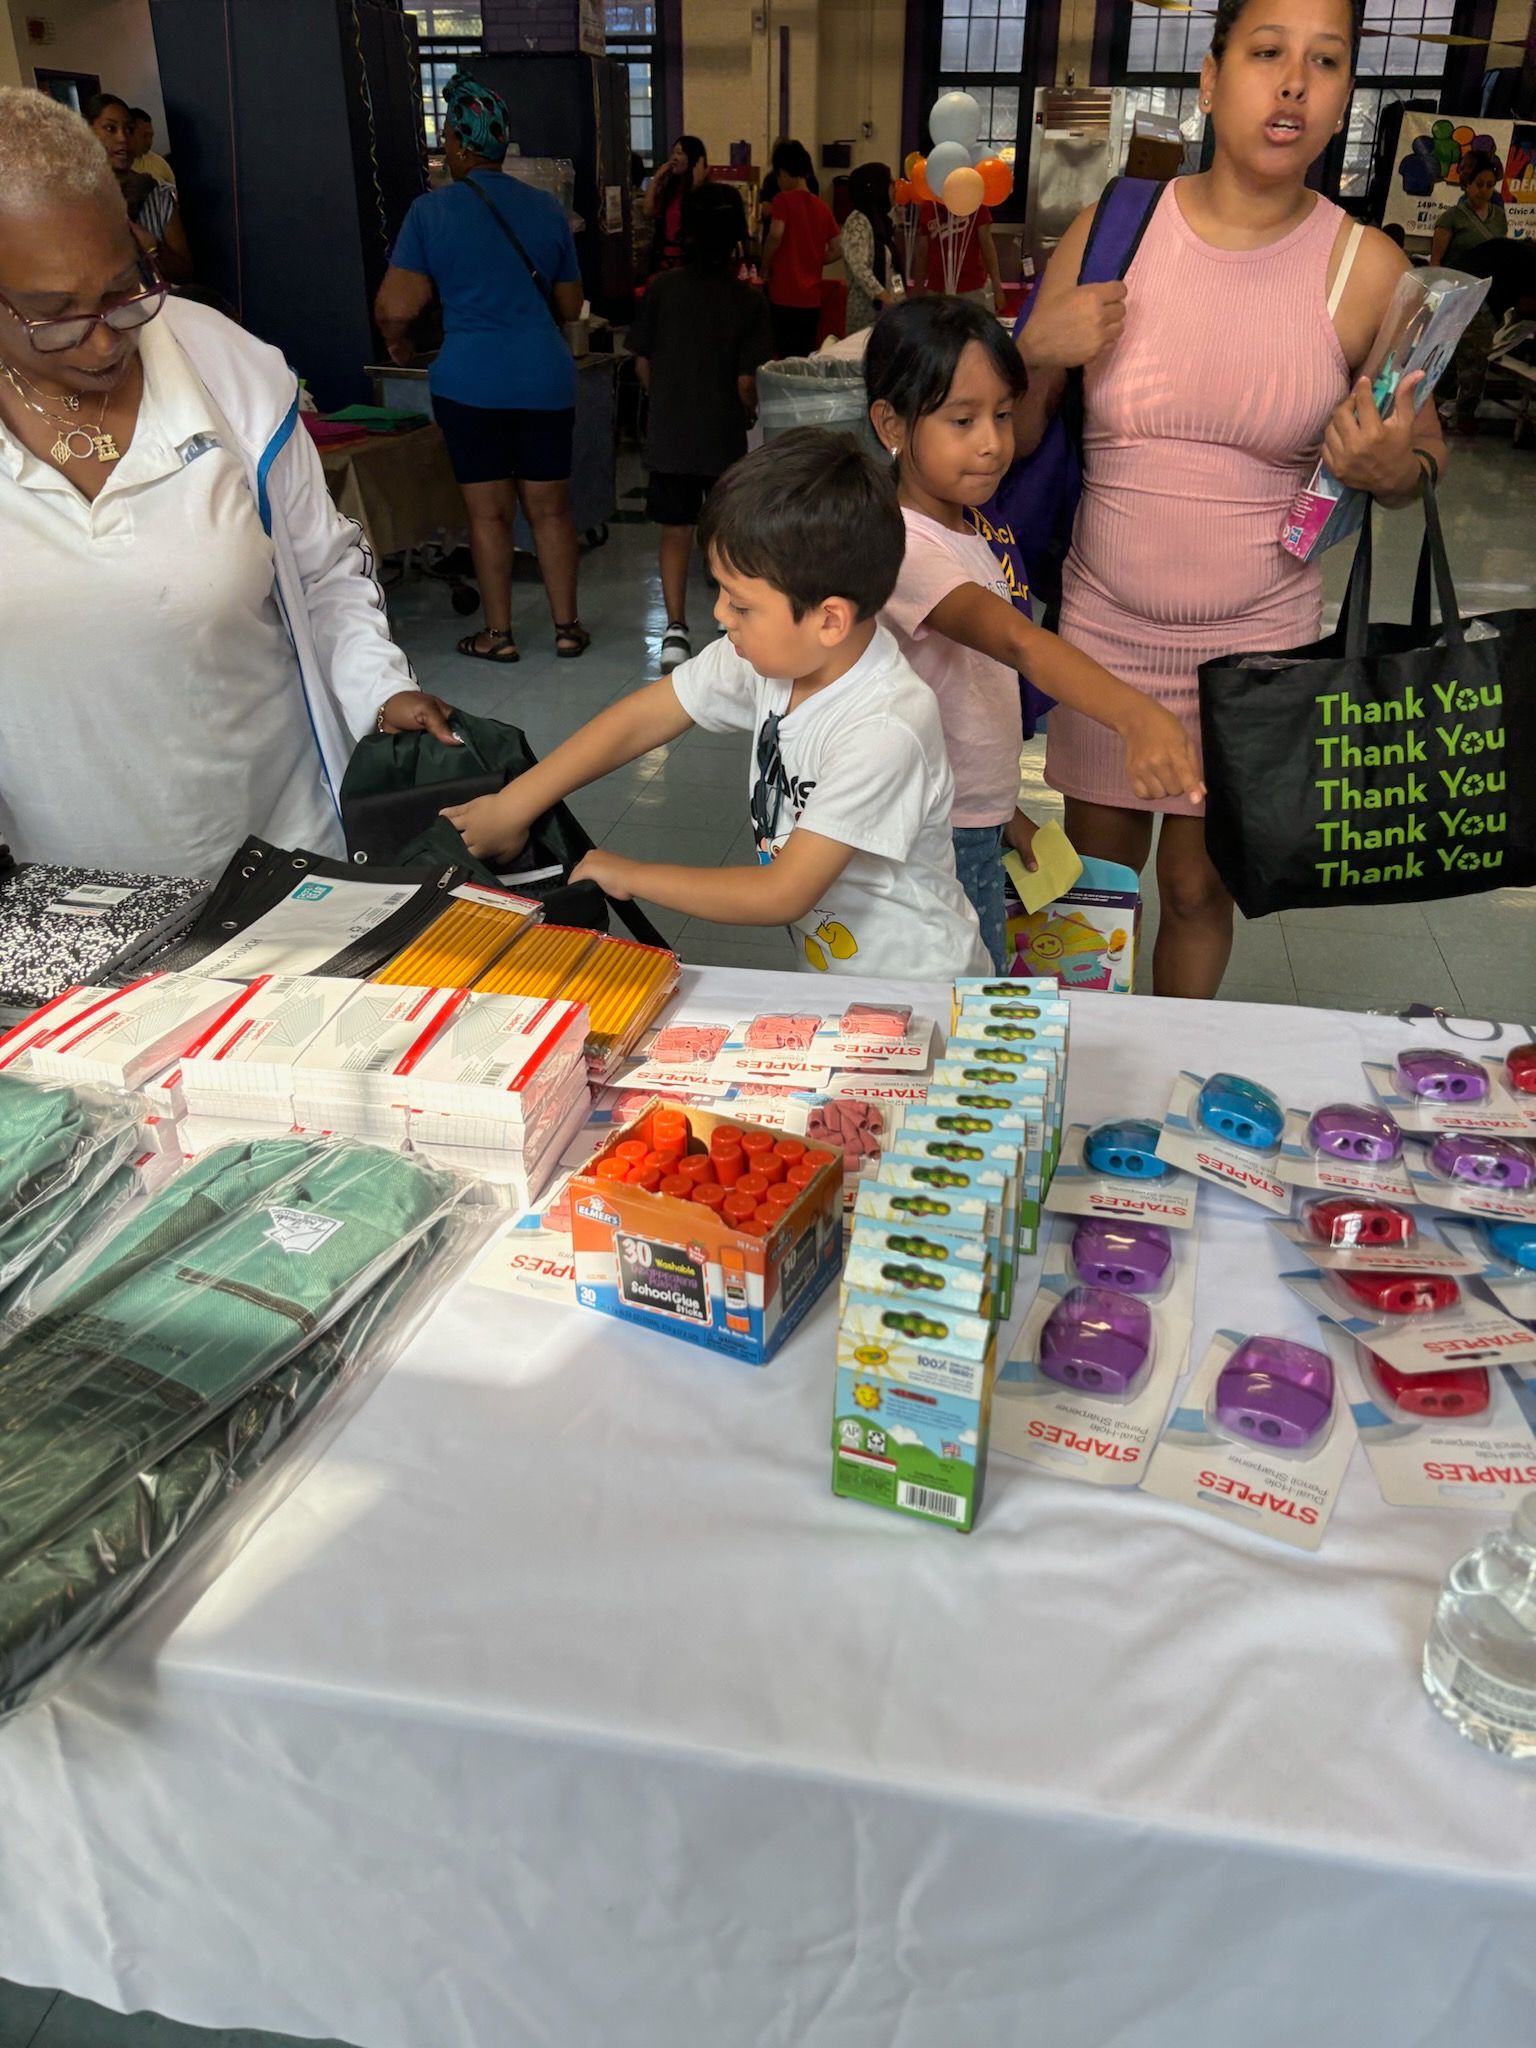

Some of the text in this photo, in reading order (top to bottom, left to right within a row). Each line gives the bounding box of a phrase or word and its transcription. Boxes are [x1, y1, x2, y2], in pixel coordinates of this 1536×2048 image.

[1315, 686, 1425, 726] Thank
[1315, 729, 1427, 769] Thank
[1315, 772, 1428, 811] Thank
[1315, 813, 1427, 851] Thank
[1315, 852, 1425, 888] Thank
[833, 1044, 921, 1056] STAPLES
[735, 1059, 823, 1072] STAPLES
[636, 1071, 724, 1086] STAPLES
[840, 1088, 928, 1099] STAPLES
[735, 1112, 785, 1125] PLES
[1196, 1152, 1285, 1198] STAPLES
[577, 1204, 619, 1225] ELMER'S
[1089, 1194, 1187, 1217] STAPLES
[1460, 1196, 1536, 1216] APLES
[621, 1237, 653, 1268] 30
[655, 1258, 696, 1276] Washable
[580, 1286, 597, 1302] 30
[631, 1280, 700, 1310] School Glue
[675, 1304, 703, 1319] Sticks
[1423, 1331, 1535, 1353] STAPLES
[917, 1354, 947, 1370] 100%
[1055, 1403, 1119, 1431] Sharpener
[1027, 1419, 1140, 1463] STAPLES
[1423, 1461, 1536, 1485] STAPLES
[1197, 1469, 1319, 1526] STAPLES
